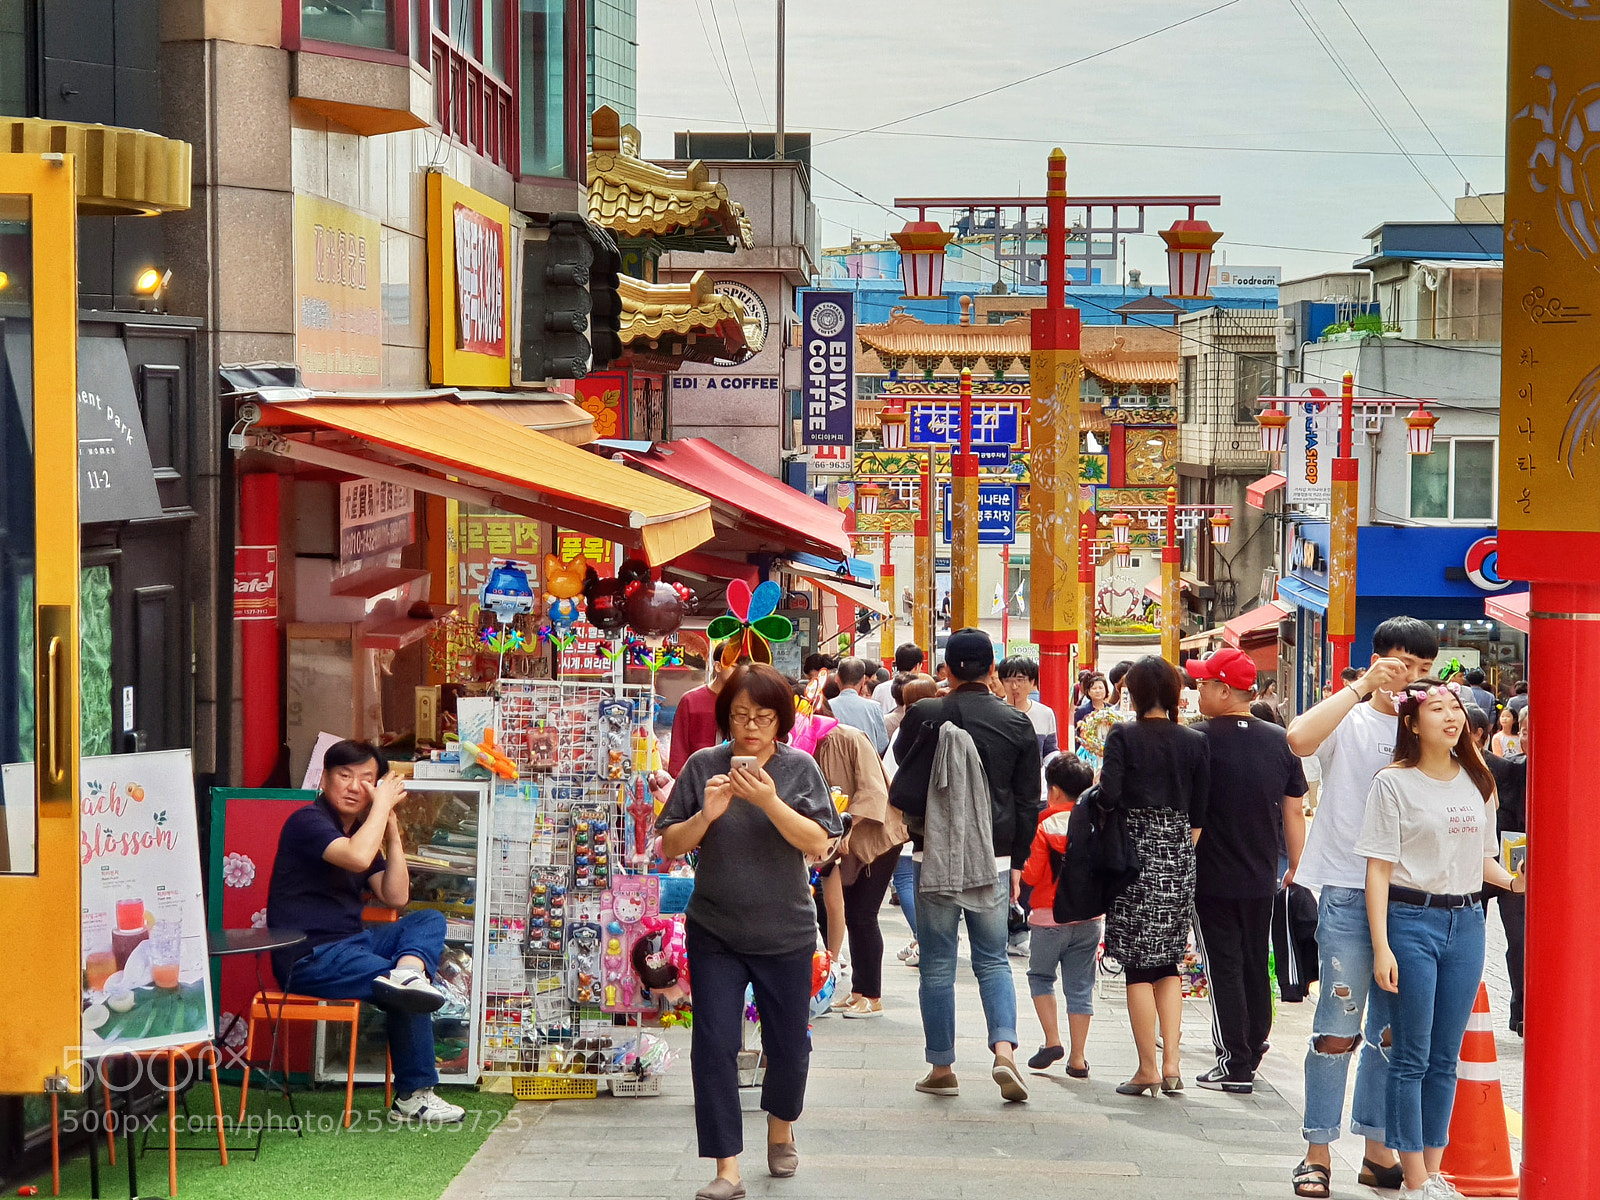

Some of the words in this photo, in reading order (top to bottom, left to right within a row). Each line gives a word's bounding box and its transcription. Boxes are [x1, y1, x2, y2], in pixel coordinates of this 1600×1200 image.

[1233, 275, 1275, 285] Foodream
[829, 341, 847, 411] EDIYA
[720, 377, 779, 389] COFFEE
[809, 339, 827, 431] COFFEE
[107, 405, 134, 445] park
[88, 446, 116, 455] women
[813, 461, 851, 470] 66-9635
[87, 470, 111, 489] 11-2
[1462, 815, 1476, 823] LOVE
